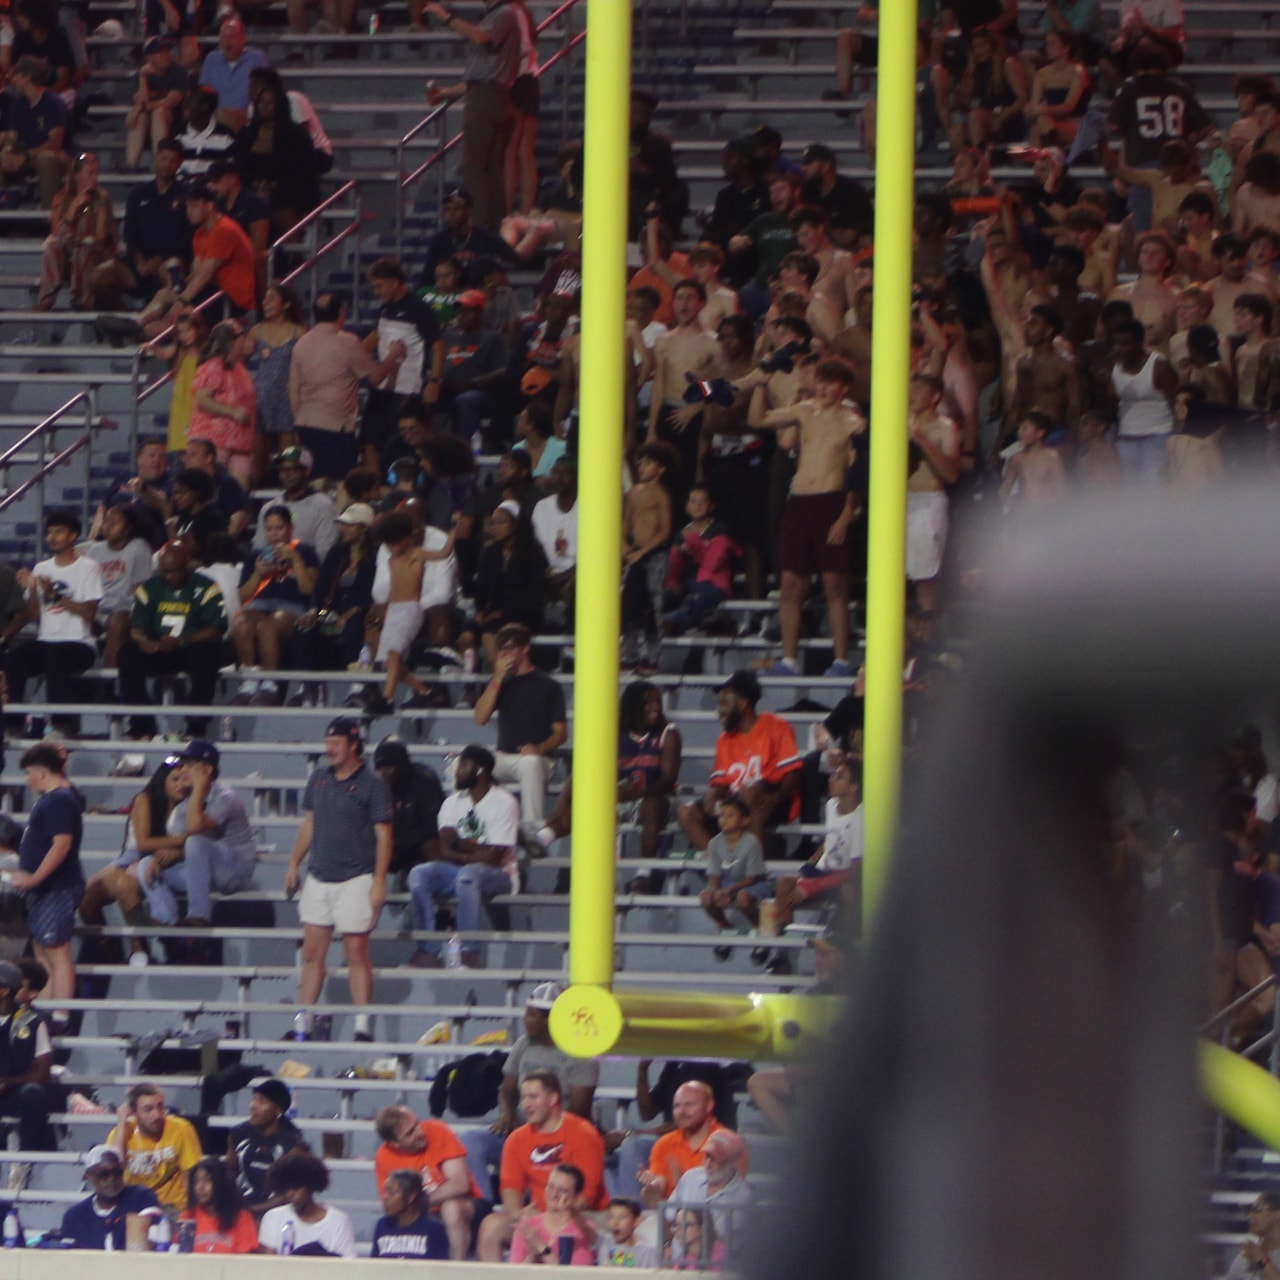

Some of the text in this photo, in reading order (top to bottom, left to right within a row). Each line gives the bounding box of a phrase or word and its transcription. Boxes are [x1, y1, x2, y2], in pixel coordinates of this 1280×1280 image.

[1136, 95, 1186, 139] 58
[160, 614, 187, 639] 7
[377, 1234, 428, 1256] VIRGINIA
